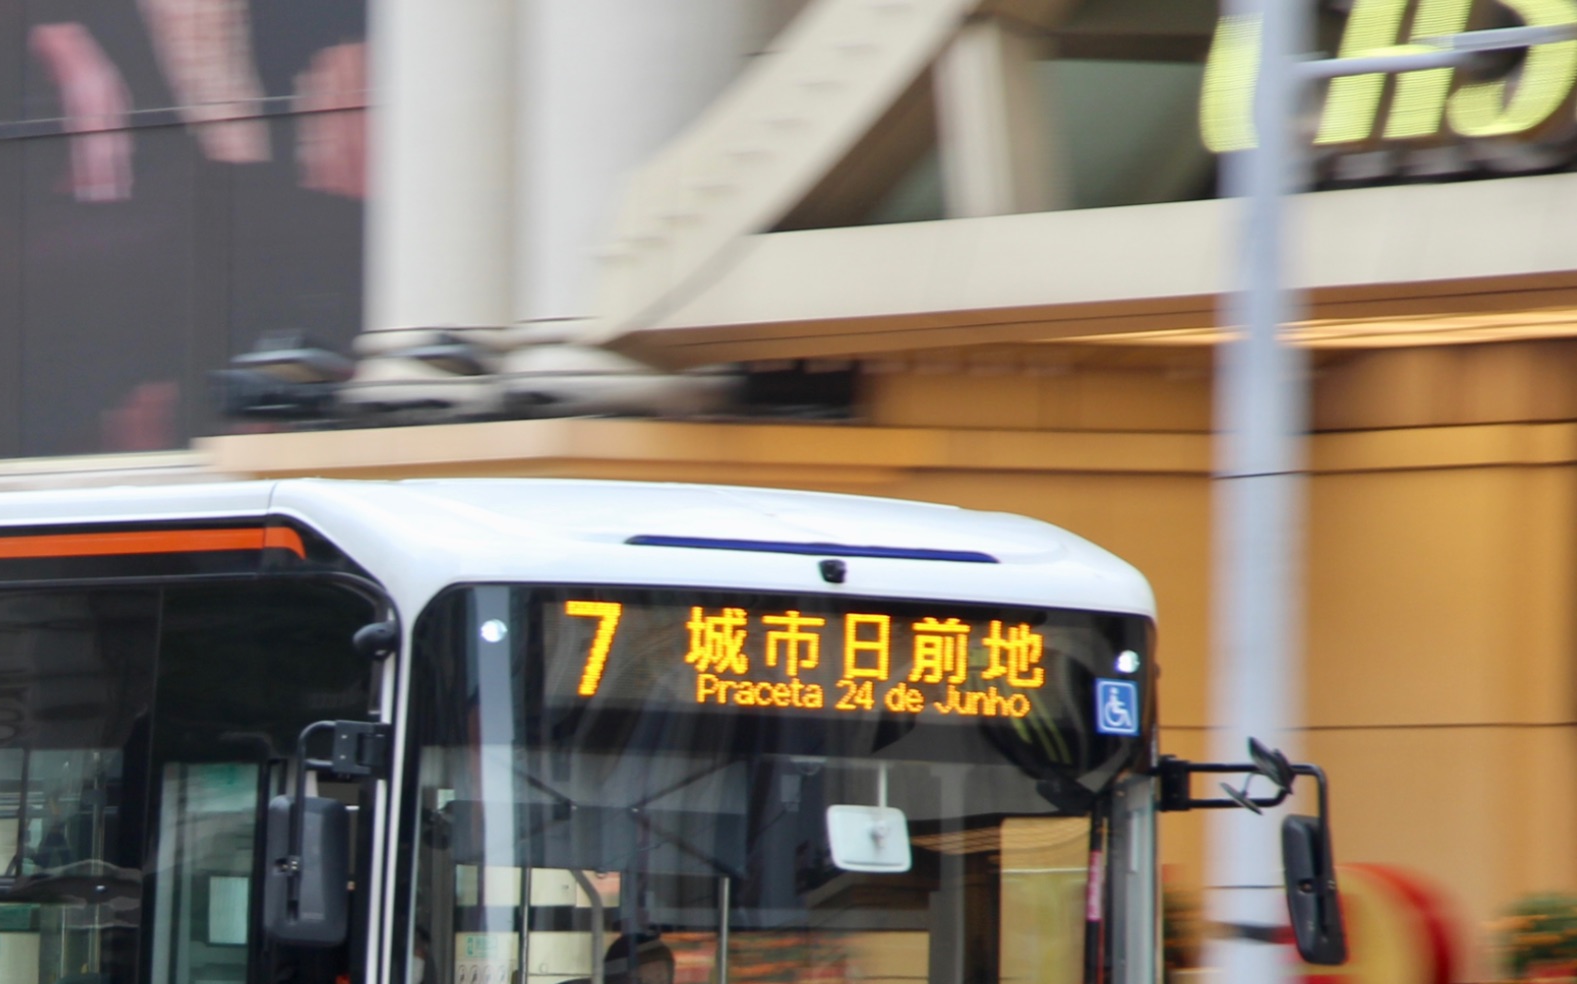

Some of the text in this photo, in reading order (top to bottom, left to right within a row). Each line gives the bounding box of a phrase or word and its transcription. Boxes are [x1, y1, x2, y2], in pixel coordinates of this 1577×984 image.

[565, 600, 622, 697] 7
[683, 606, 1045, 690] 城市日前地
[696, 673, 1031, 718] Praceta 24 de Junho
